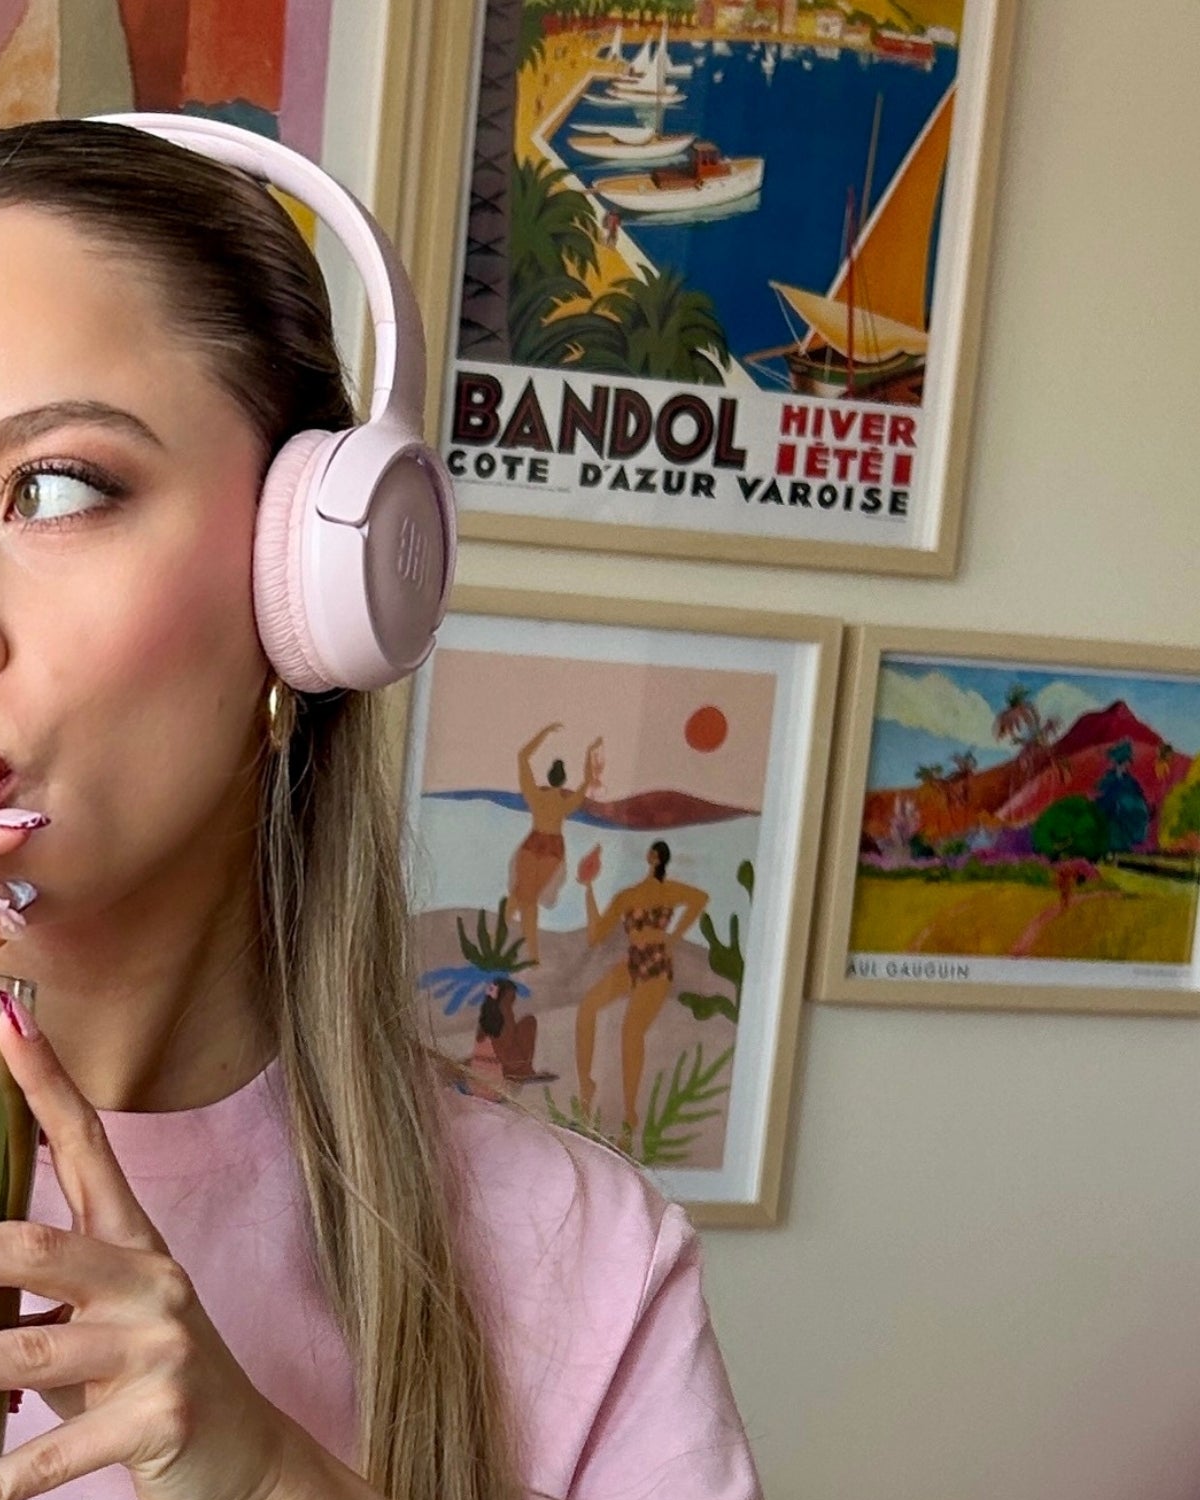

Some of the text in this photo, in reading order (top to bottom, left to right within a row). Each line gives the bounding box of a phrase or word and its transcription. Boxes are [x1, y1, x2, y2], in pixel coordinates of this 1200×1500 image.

[451, 370, 748, 470] BANDOL
[780, 403, 917, 447] HIVER
[447, 449, 550, 483] COTE
[579, 462, 717, 499] D'AZUR
[737, 475, 909, 516] VAROISE
[886, 961, 970, 980] GAUGUIN
